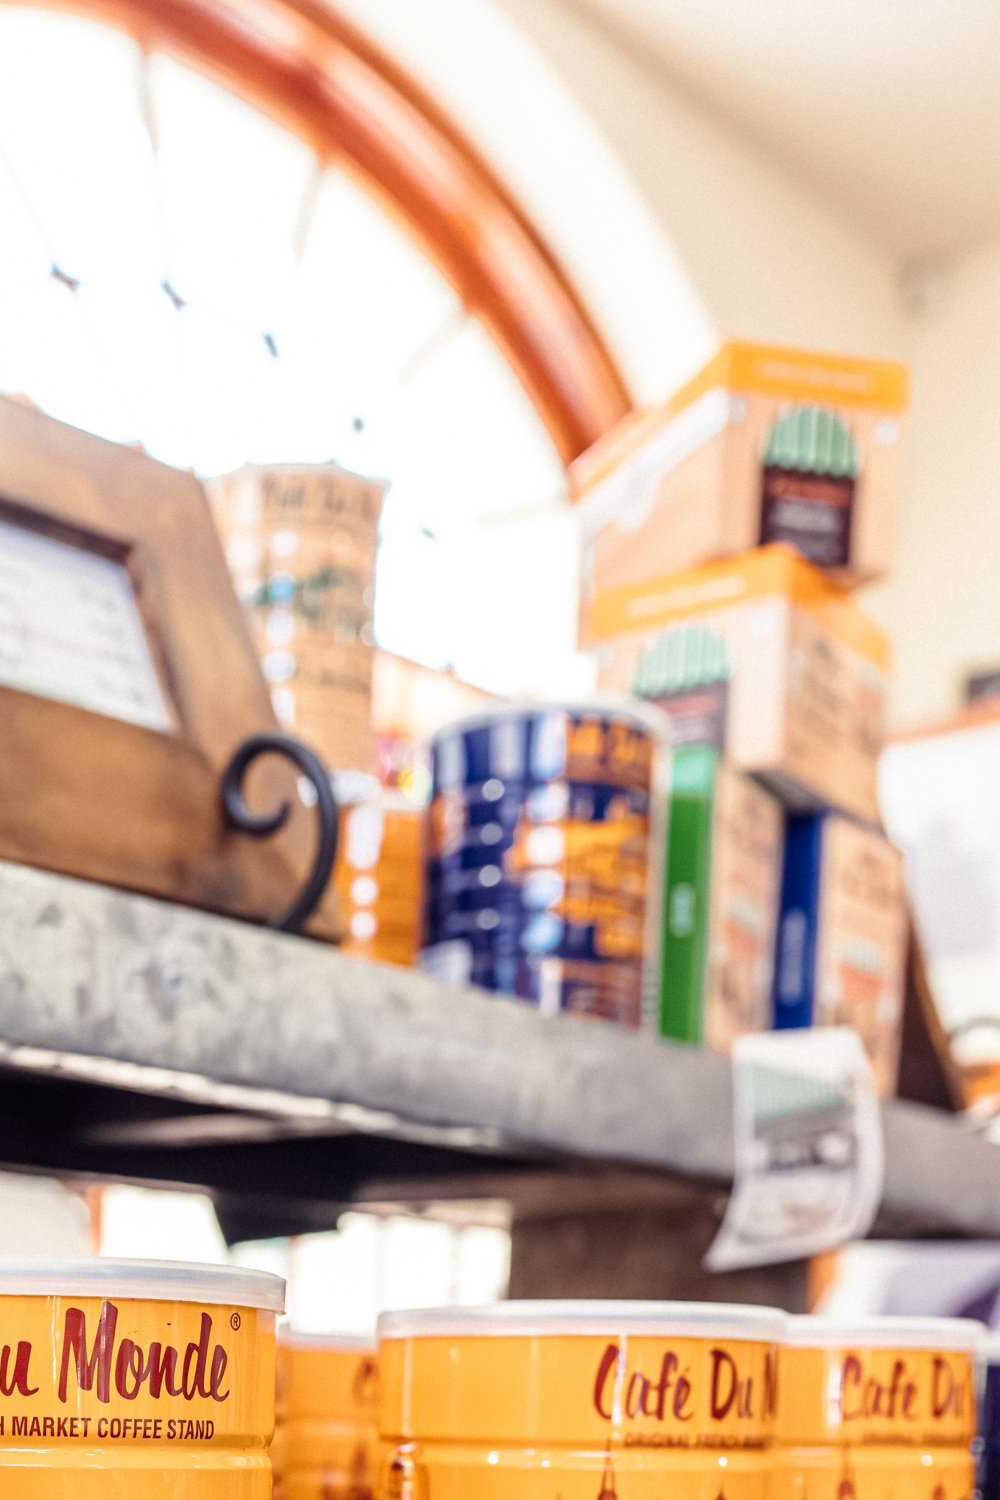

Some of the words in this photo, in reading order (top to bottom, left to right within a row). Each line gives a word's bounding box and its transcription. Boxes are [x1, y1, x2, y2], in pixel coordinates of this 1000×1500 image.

[594, 1344, 694, 1421] Café
[711, 1348, 754, 1421] Du
[11, 1416, 90, 1439] MARKET
[97, 1418, 163, 1440] COFFEE
[167, 1419, 216, 1441] STAND
